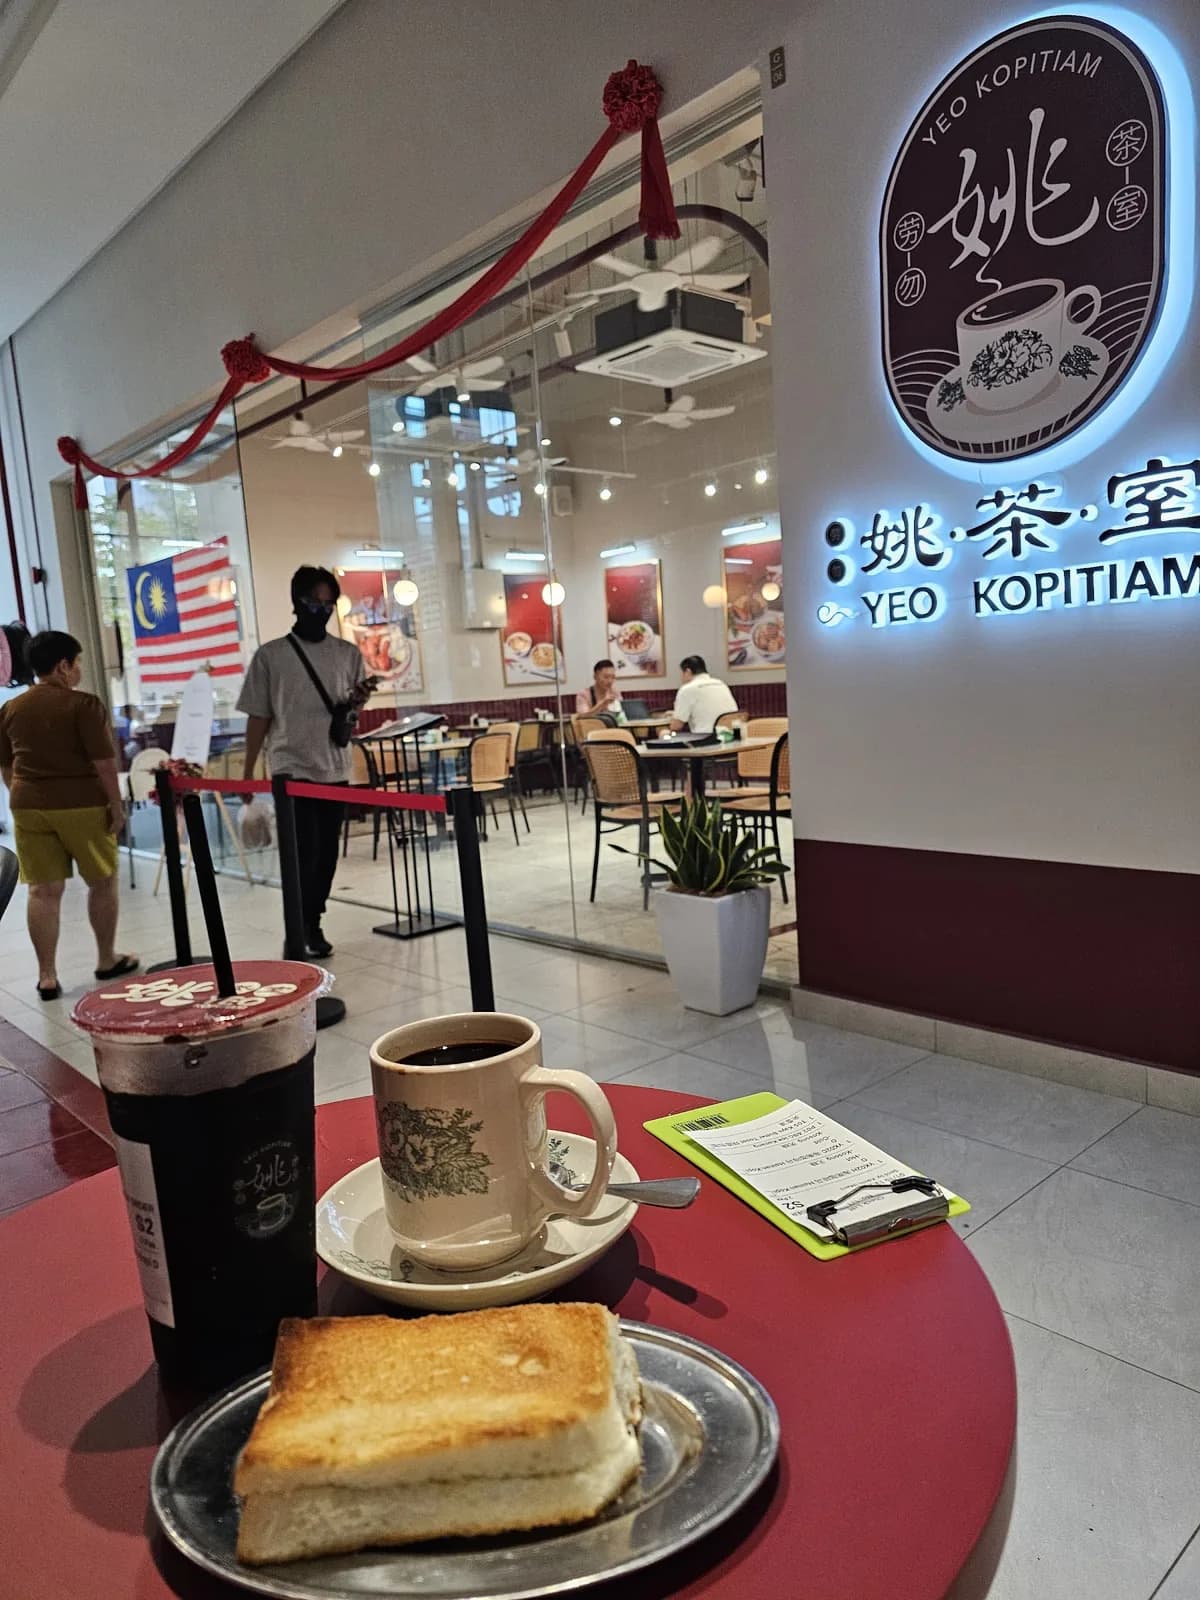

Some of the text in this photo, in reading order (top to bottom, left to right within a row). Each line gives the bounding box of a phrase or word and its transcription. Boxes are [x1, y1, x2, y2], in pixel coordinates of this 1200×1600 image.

[921, 49, 1103, 147] YEO KOPITIAM
[926, 107, 1100, 270] 姚
[861, 553, 1200, 625] YEO KOPITIAM
[782, 1201, 804, 1210] S2
